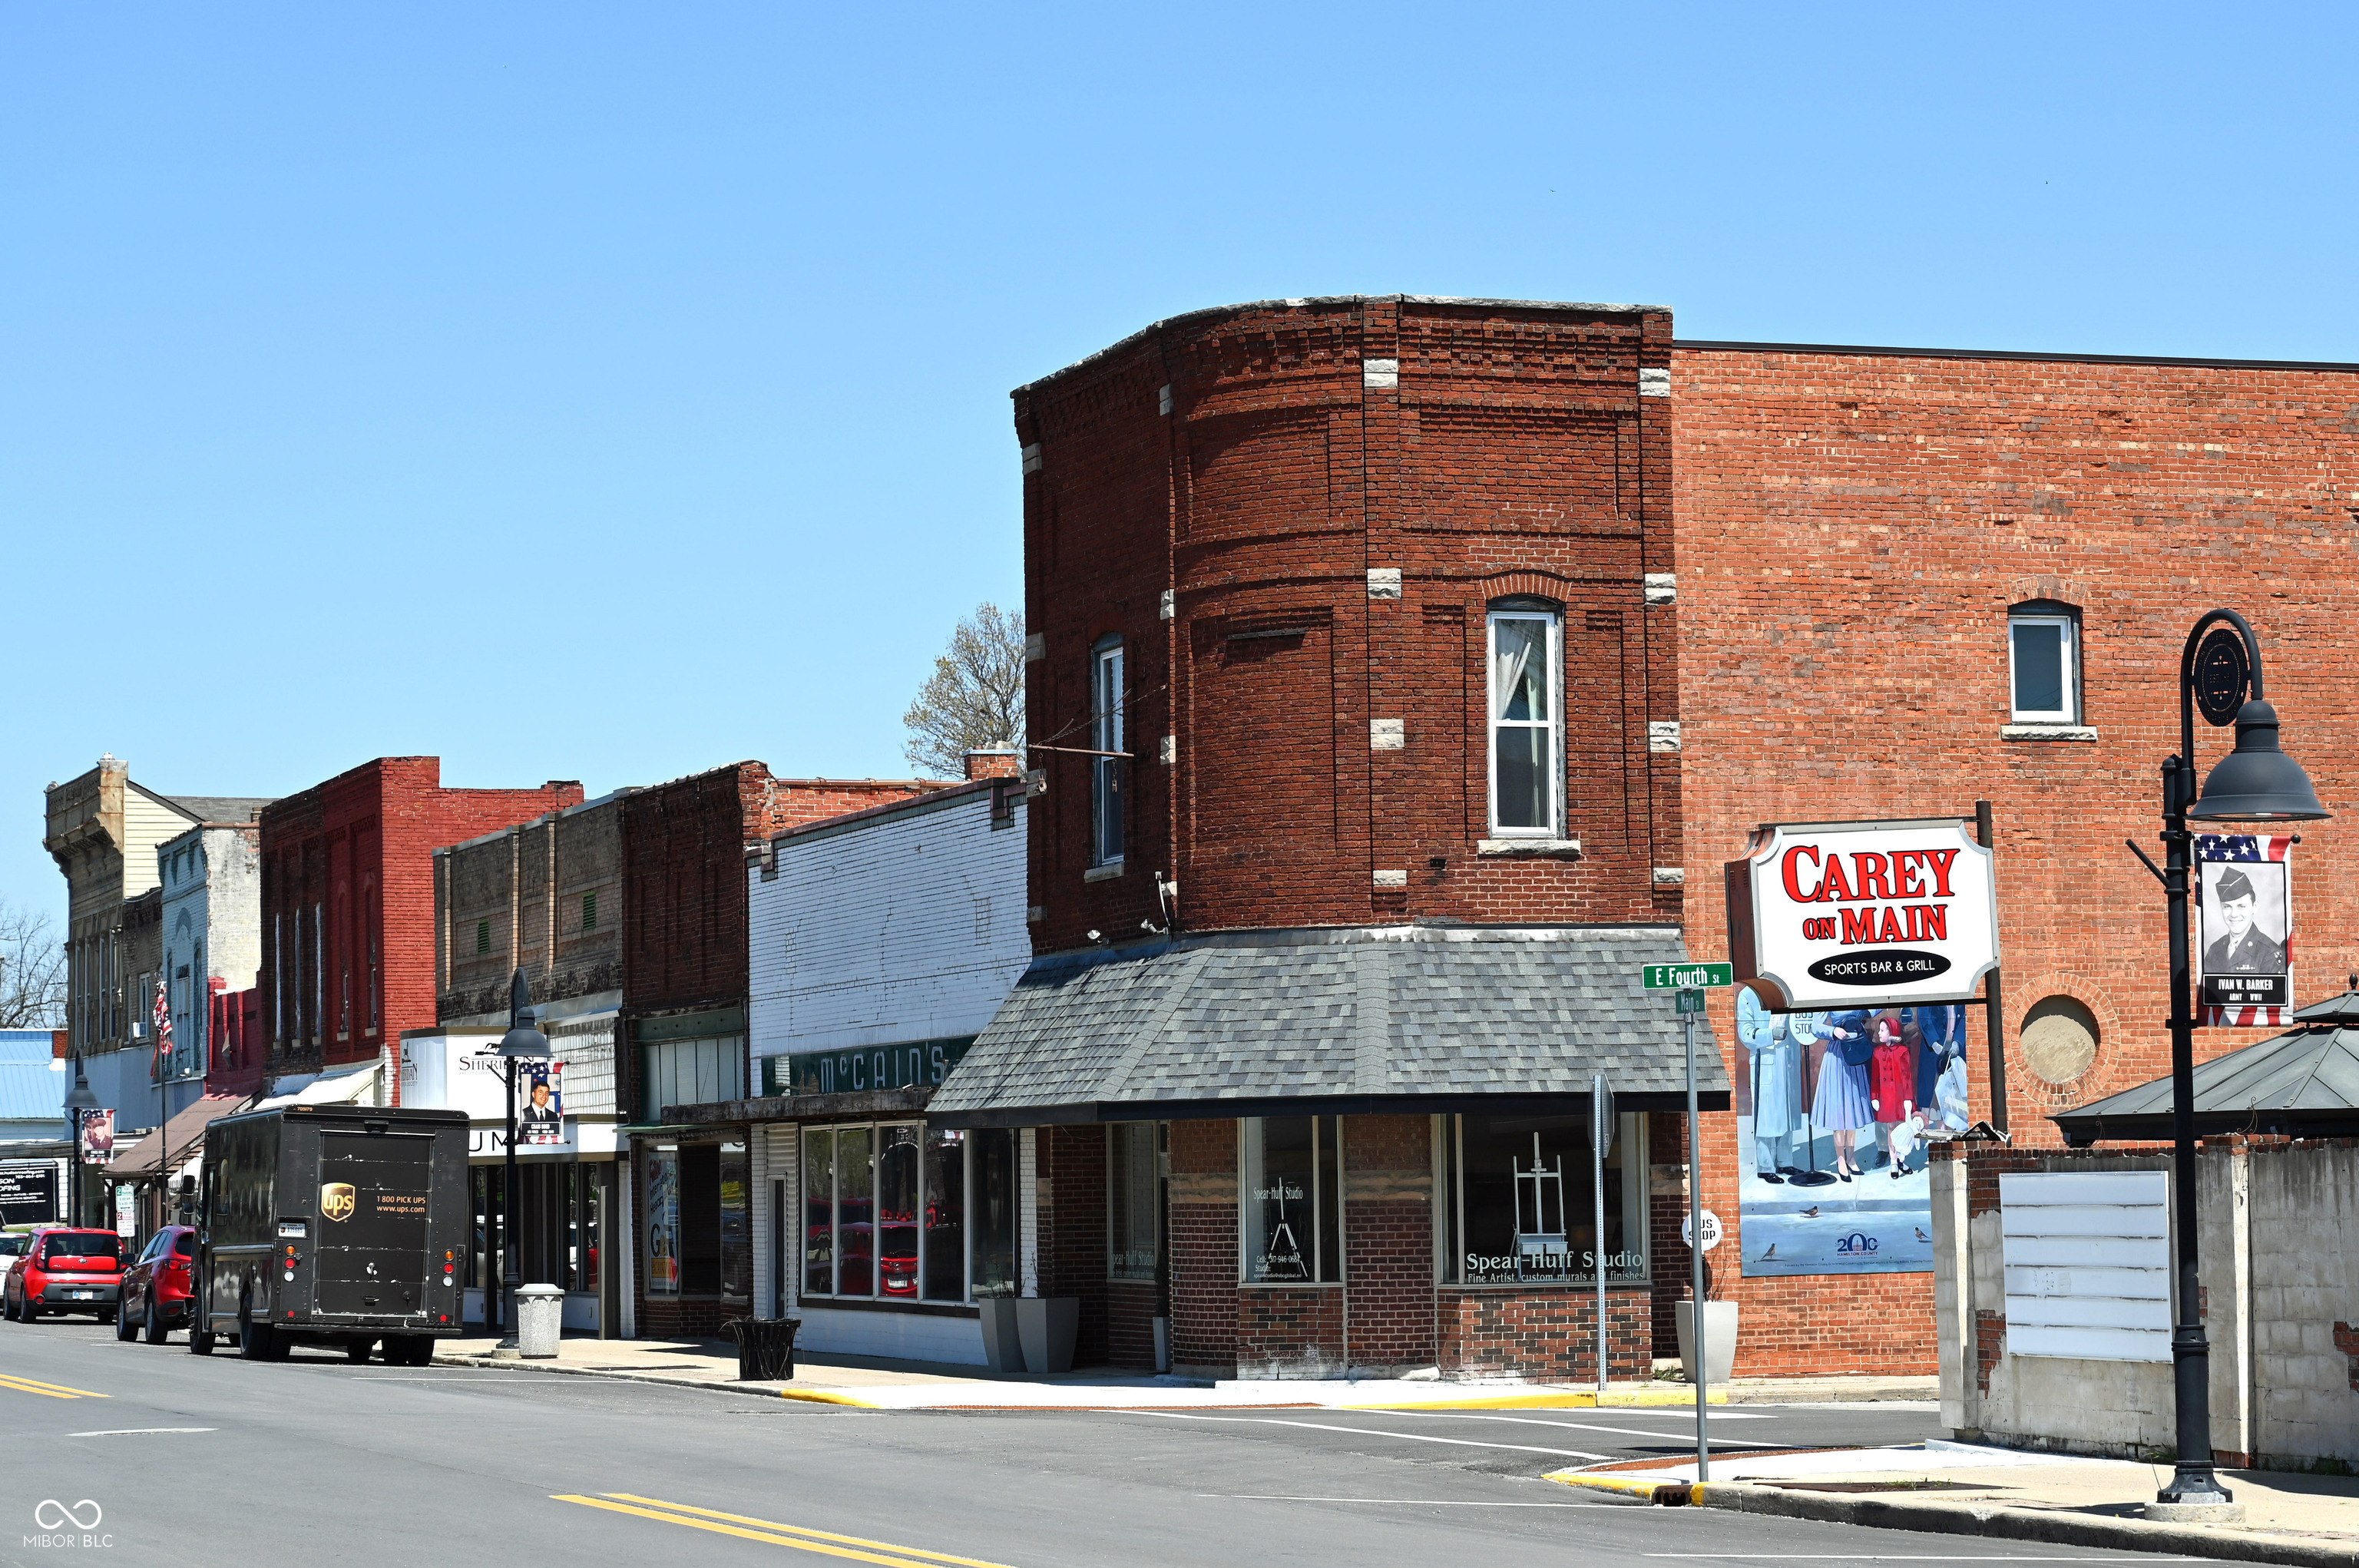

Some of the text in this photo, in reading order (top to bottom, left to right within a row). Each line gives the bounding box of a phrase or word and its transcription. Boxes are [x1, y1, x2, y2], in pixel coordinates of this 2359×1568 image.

[1782, 845, 1961, 903] CAREY
[1802, 904, 1948, 944] ON MAIN
[1824, 959, 1935, 976] SPORTS BAR & GRILL
[1656, 967, 1720, 986] E Fourth St
[2218, 979, 2273, 991] IVAN W. BARKER
[1680, 993, 1695, 1011] Main
[2229, 993, 2262, 1001] ARMY WWII
[117, 1187, 121, 1196] 2
[1253, 1186, 1303, 1203] Spear-Huff Studio
[323, 1194, 353, 1216] ups
[376, 1206, 425, 1214] www.ups.com
[1700, 1219, 1712, 1229] US
[1689, 1230, 1716, 1240] SOP
[1138, 1250, 1155, 1266] Studio
[1467, 1249, 1643, 1274] Spear-Huff Sudio
[1467, 1273, 1487, 1284] Fine
[1490, 1273, 1518, 1283] Artist,
[1521, 1273, 1556, 1282] custom
[1557, 1272, 1587, 1282] murals
[1610, 1270, 1644, 1281] finishes
